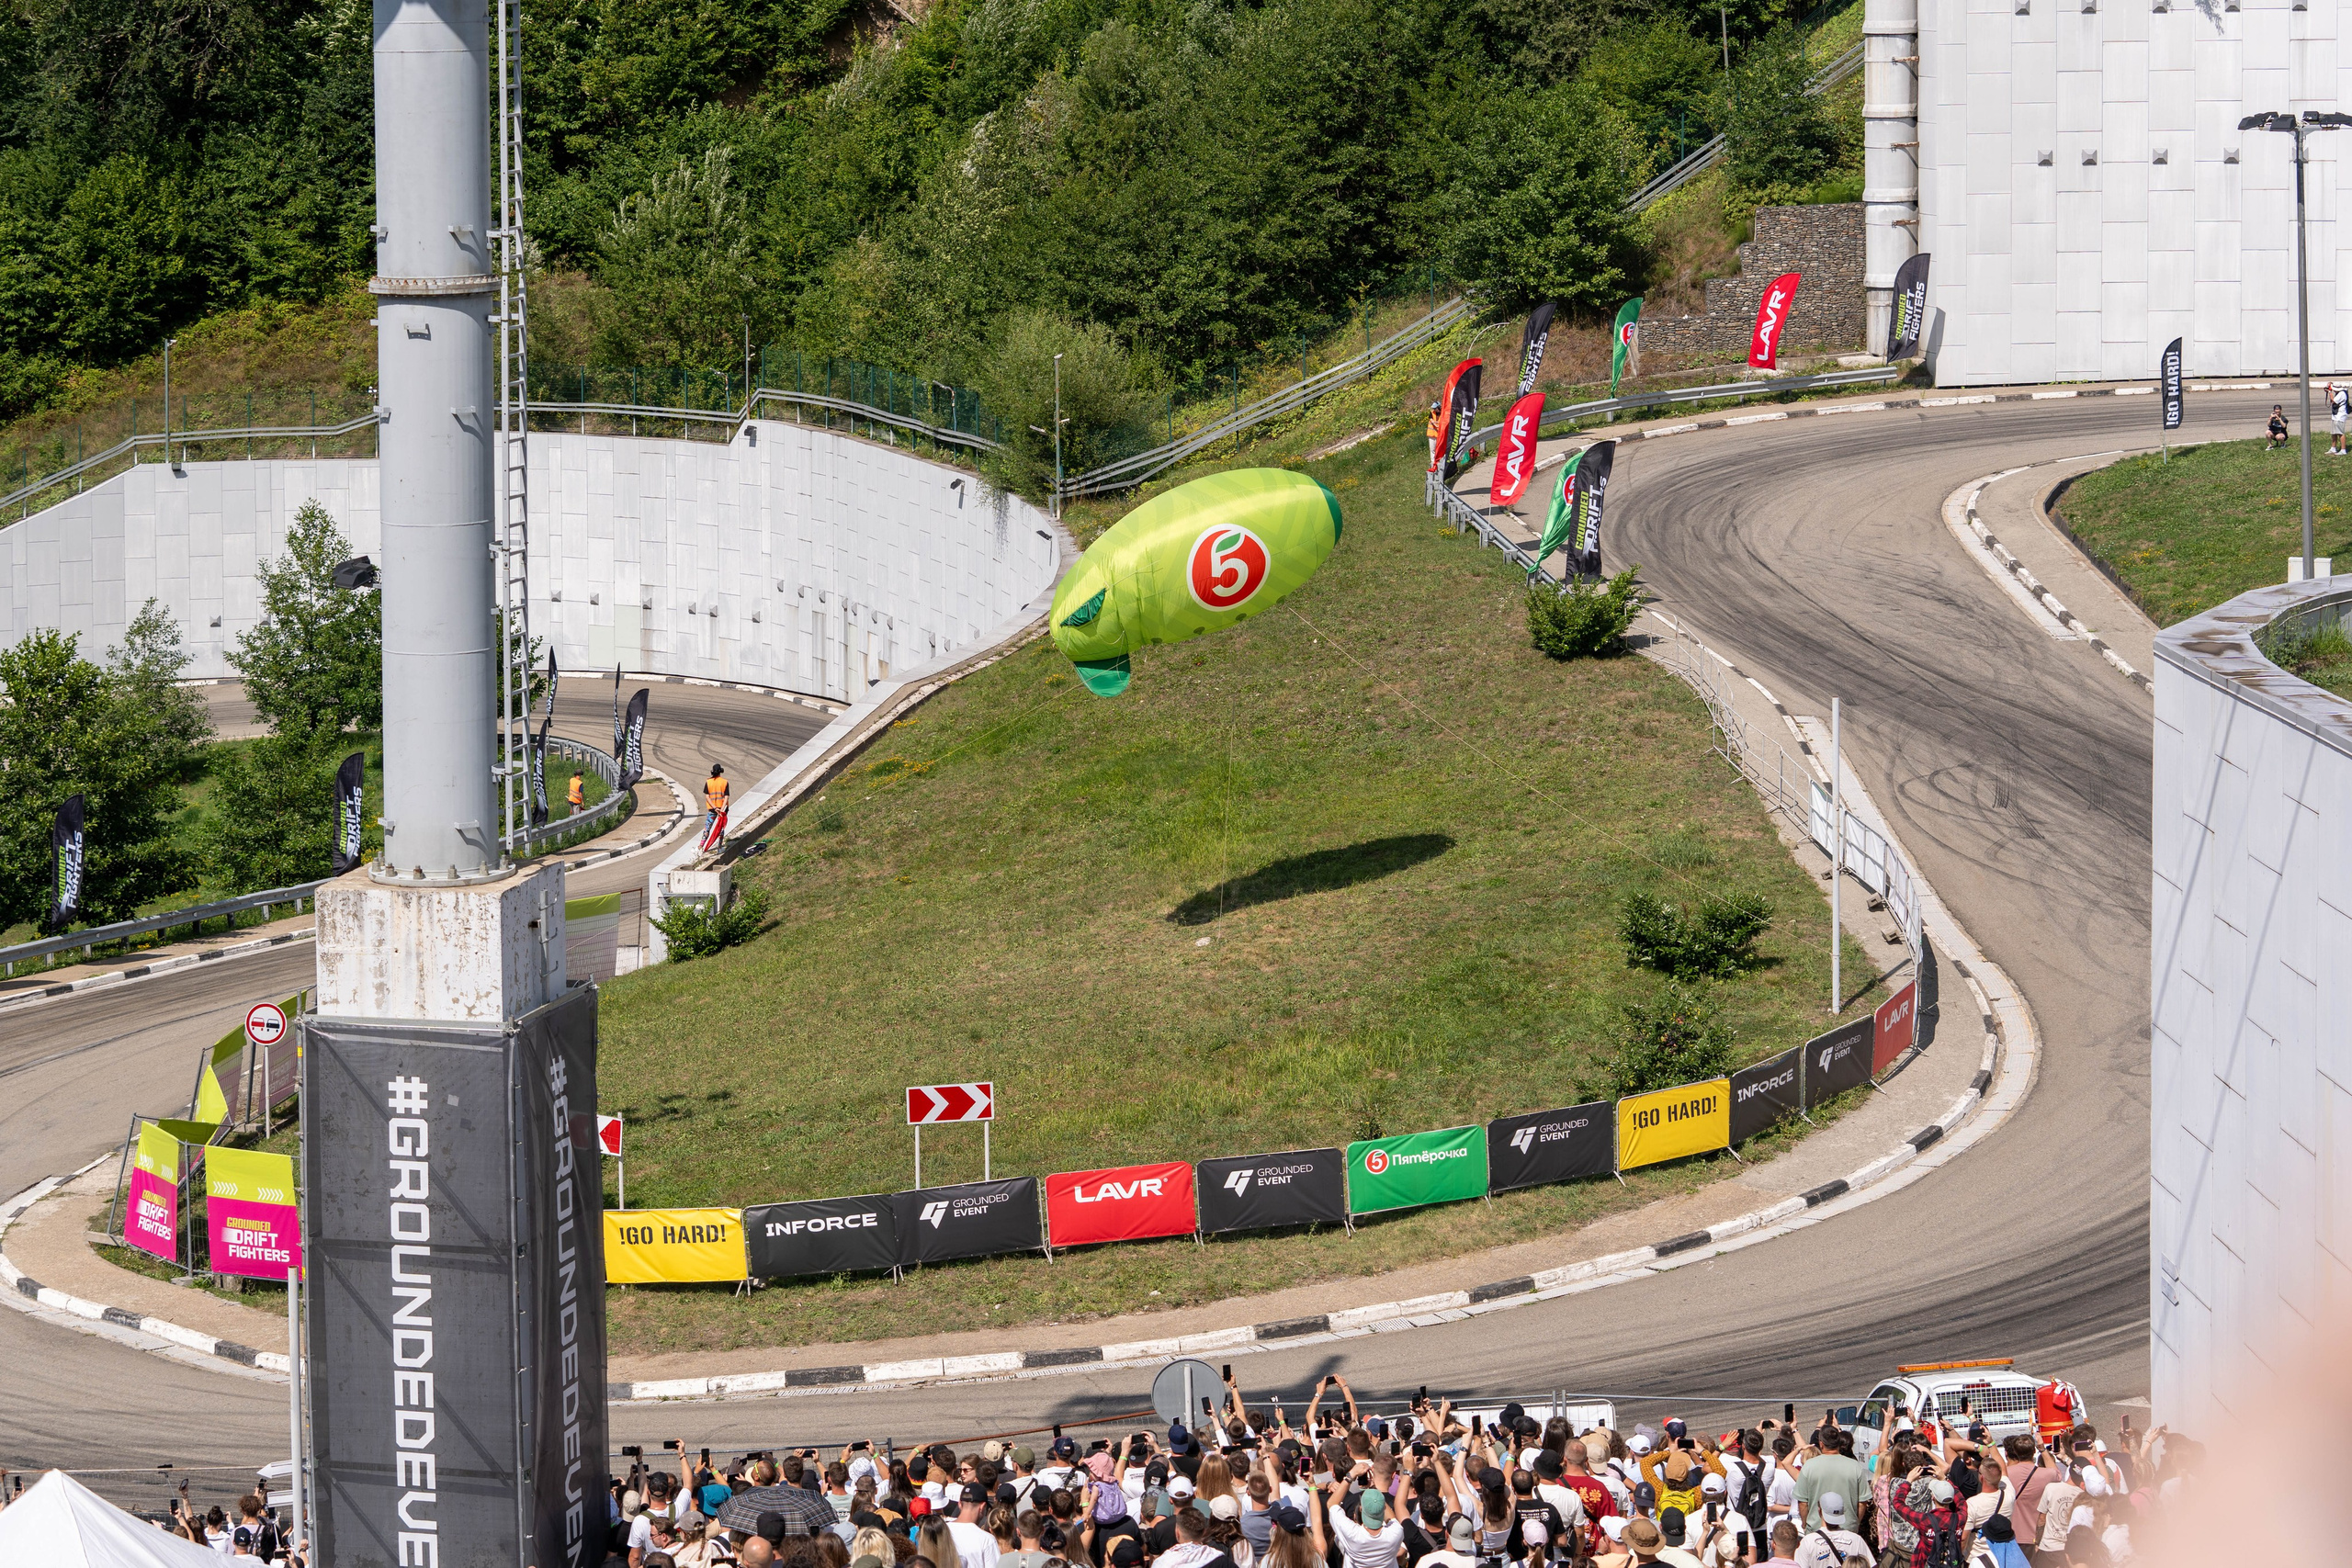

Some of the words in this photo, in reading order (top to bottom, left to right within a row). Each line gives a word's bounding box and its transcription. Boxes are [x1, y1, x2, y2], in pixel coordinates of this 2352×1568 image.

[1757, 290, 1786, 361] LAVR
[1895, 294, 1906, 341] GROUNDED
[1903, 288, 1916, 334] DRIFT
[1909, 281, 1925, 341] FIGHTERS
[1525, 332, 1548, 392] FIGHTERS
[2166, 351, 2180, 397] HARD!
[1500, 415, 1530, 497] LAVR
[1575, 491, 1589, 550] GROUNDED
[1583, 484, 1601, 544] DRIFT
[1210, 531, 1250, 598] 5
[632, 715, 644, 773] FIGHTERS
[339, 801, 347, 855] GROUNDED
[345, 795, 356, 850] DRIFT
[353, 785, 363, 857] FIGHTERS
[58, 845, 67, 904] GROUNDED
[62, 839, 76, 900] DRIFT
[67, 830, 83, 908] FIGHTERS
[1834, 1034, 1861, 1052] GROUNDED
[1834, 1046, 1851, 1061] EVENT
[1737, 1068, 1794, 1102] INFORCE
[1539, 1118, 1589, 1134] GROUNDED
[1633, 1107, 1660, 1131] !GO
[1668, 1095, 1718, 1122] HARD!
[1392, 1147, 1468, 1167] Пятёрочка
[1540, 1130, 1571, 1143] EVENT
[1257, 1163, 1314, 1177] GROUNDED
[1258, 1175, 1293, 1187] EVENT
[140, 1199, 169, 1224] DRIFT
[953, 1192, 1010, 1208] GROUNDED
[954, 1205, 989, 1218] EVENT
[138, 1215, 172, 1241] FIGHTERS
[226, 1216, 271, 1232] GROUNDED
[230, 1227, 278, 1248] DRIFT
[619, 1226, 653, 1245] !GO
[662, 1224, 727, 1244] HARD!
[765, 1213, 878, 1237] INFORCE
[229, 1244, 290, 1263] FIGHTERS
[388, 1076, 438, 1568] #GROUNDEDEVE
